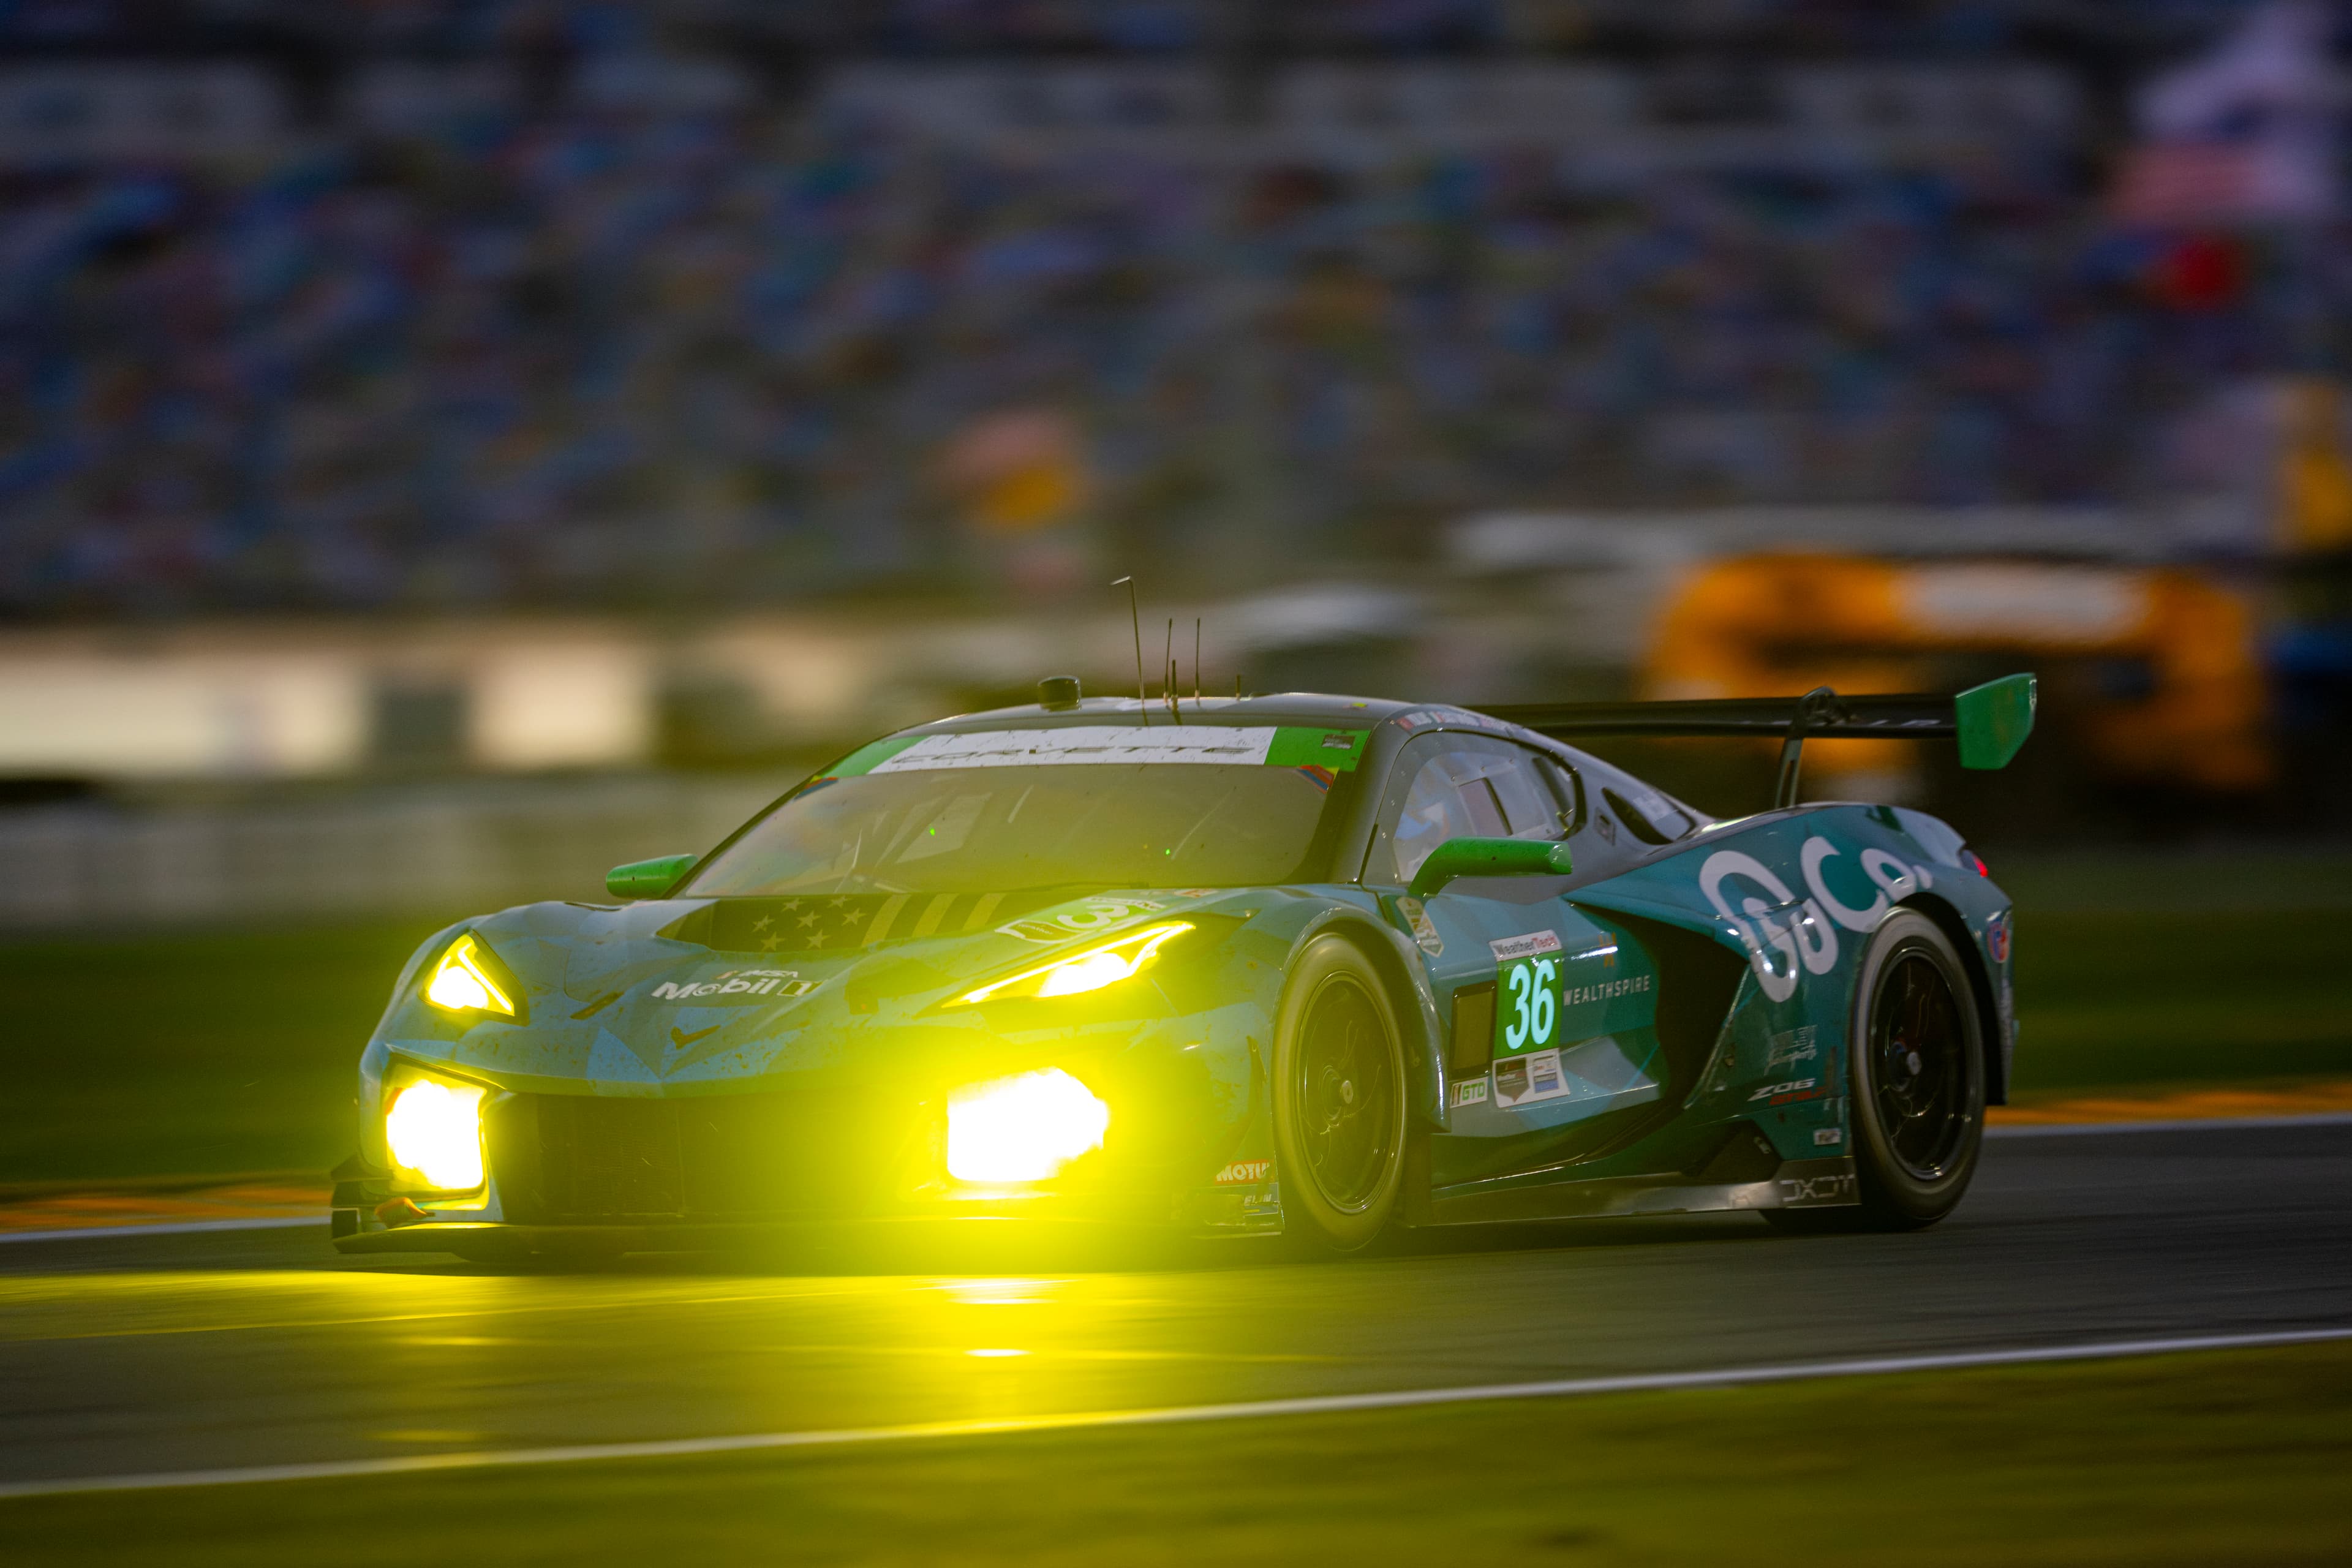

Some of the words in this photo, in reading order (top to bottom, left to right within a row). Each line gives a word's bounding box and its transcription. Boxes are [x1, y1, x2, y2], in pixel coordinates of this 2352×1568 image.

[651, 978, 782, 1000] Mobil
[1563, 975, 1650, 1006] WEALTHSPIRE
[1506, 959, 1556, 1050] 36
[1462, 1082, 1485, 1101] GTD
[1747, 1078, 1815, 1101] Z06
[1216, 1162, 1270, 1182] MOTU
